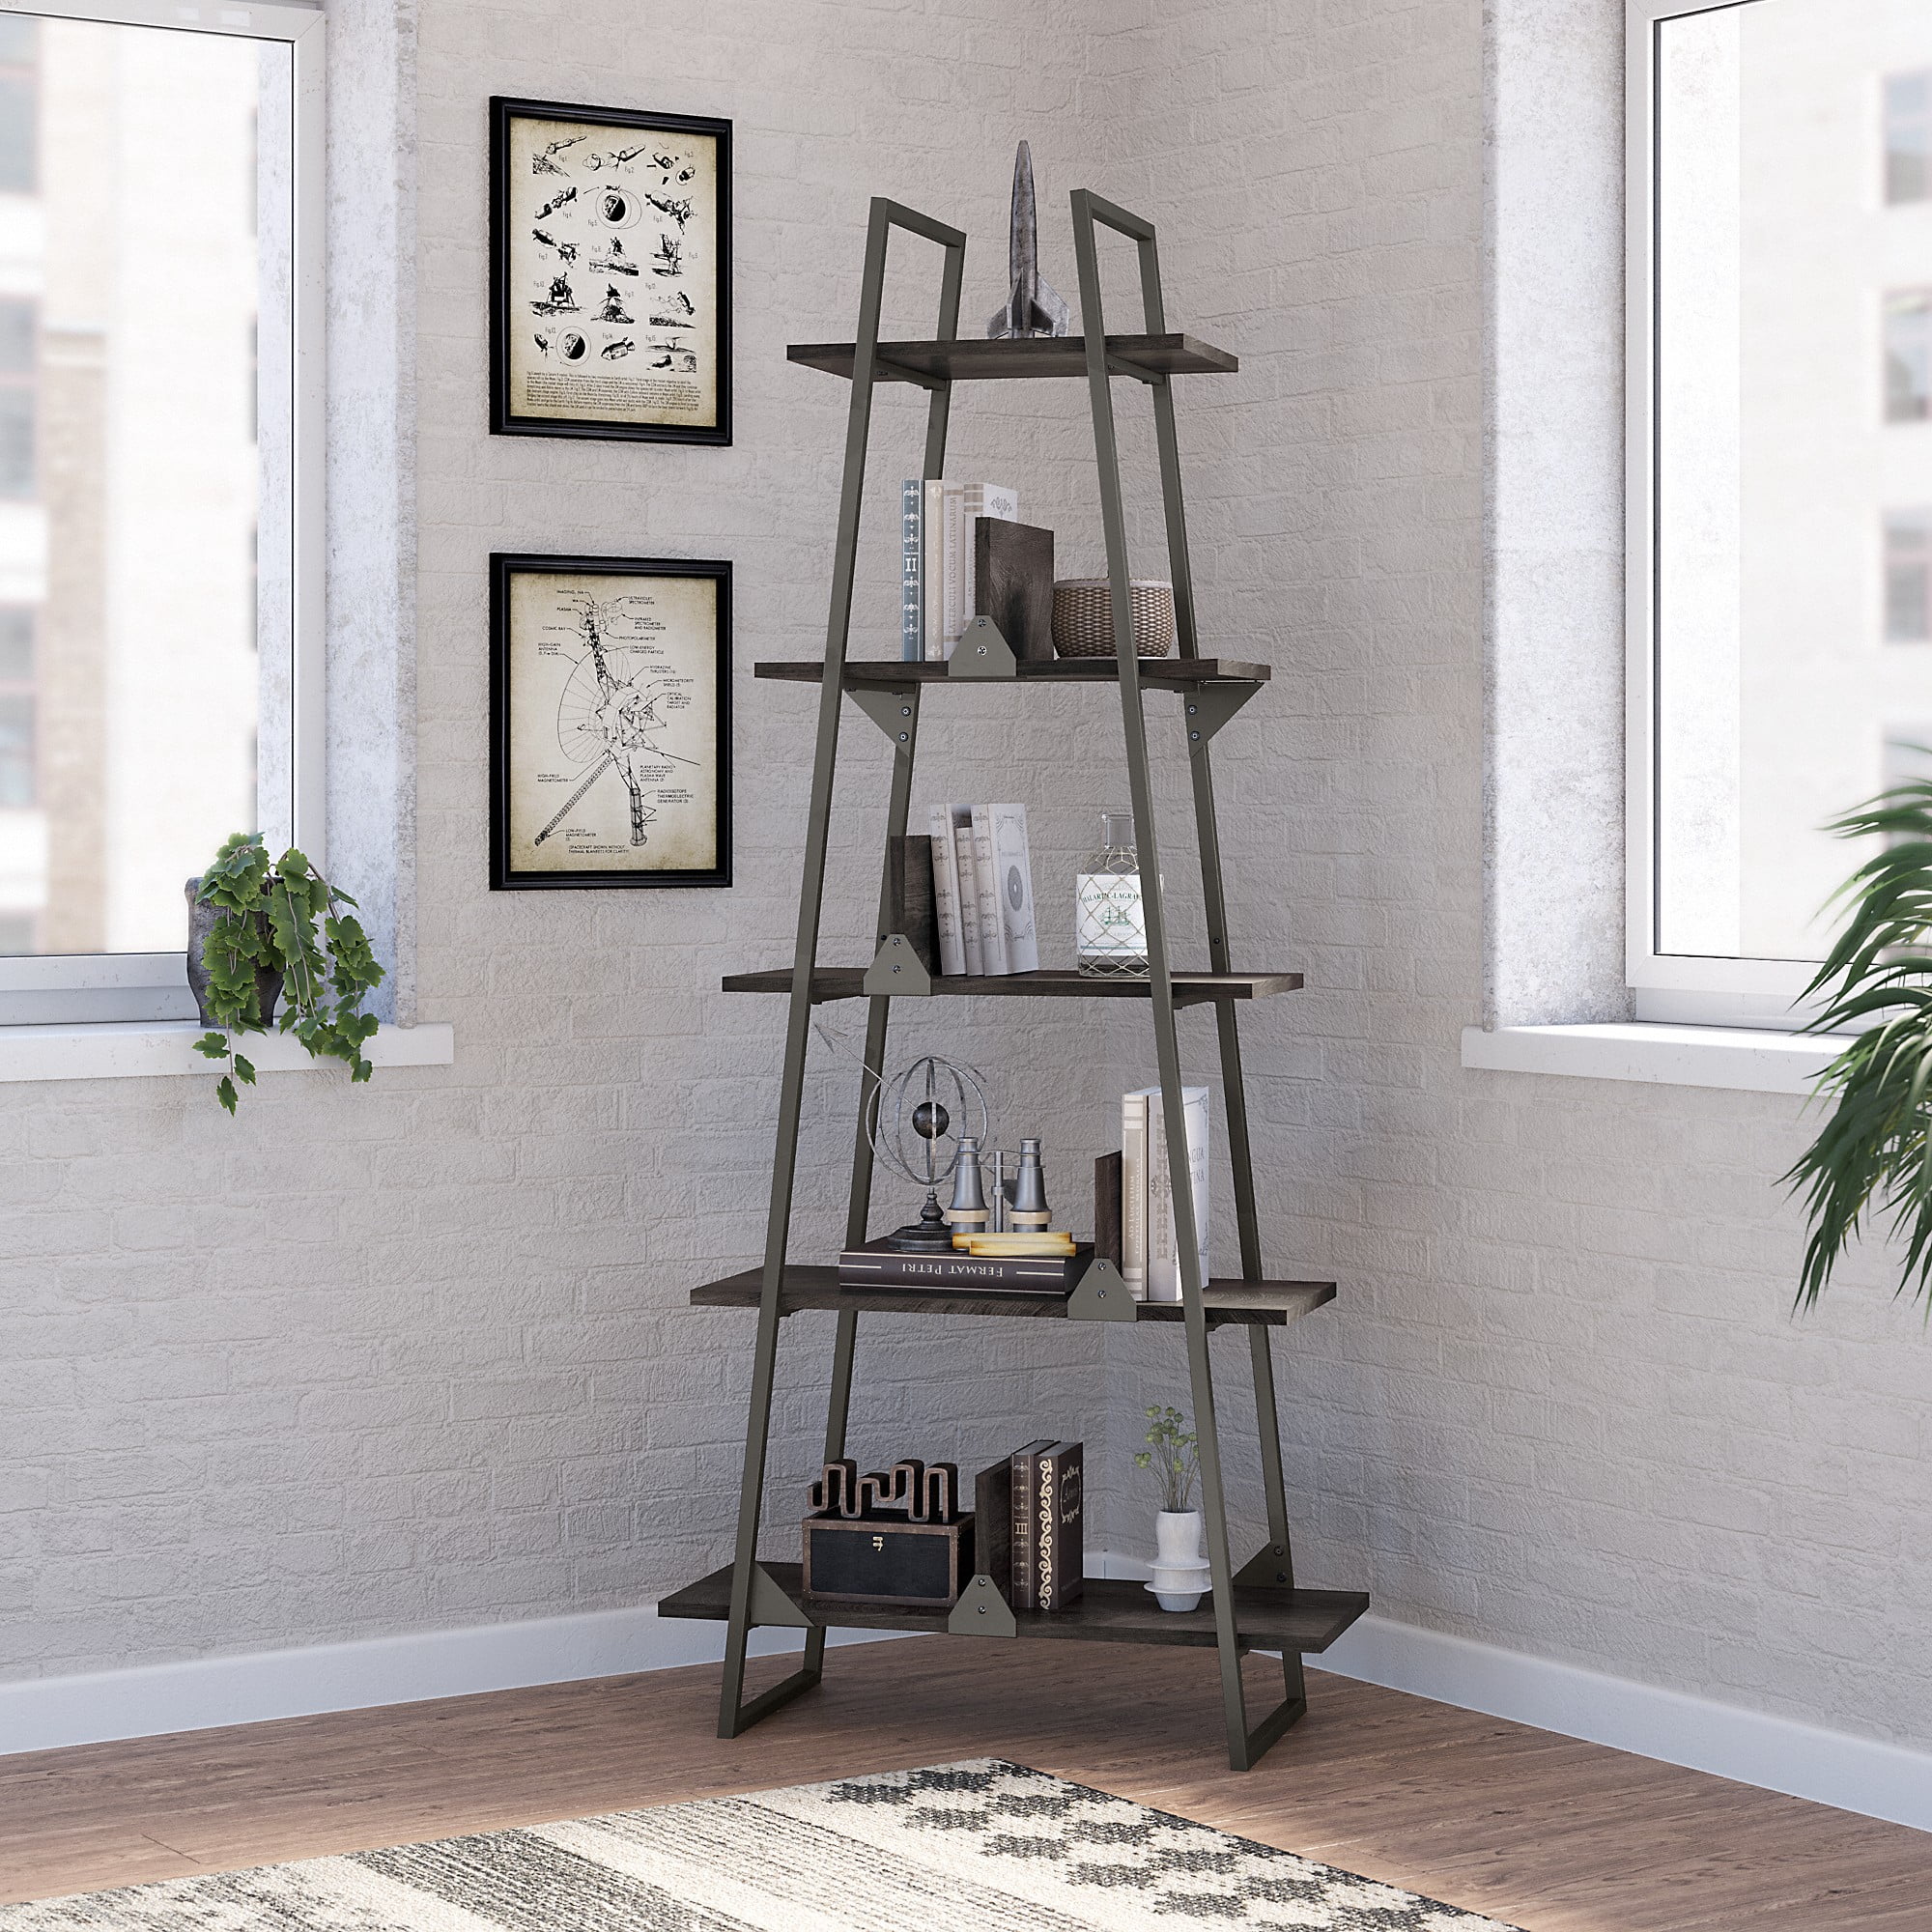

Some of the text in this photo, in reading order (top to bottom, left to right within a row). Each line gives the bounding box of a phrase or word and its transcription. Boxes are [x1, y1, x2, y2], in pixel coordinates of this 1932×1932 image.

[905, 557, 917, 572] II
[949, 497, 957, 635] LATERCULI VOCUM LATINARUM
[902, 1264, 1003, 1277] FERMAT PETRI
[1014, 1522, 1028, 1535] III
